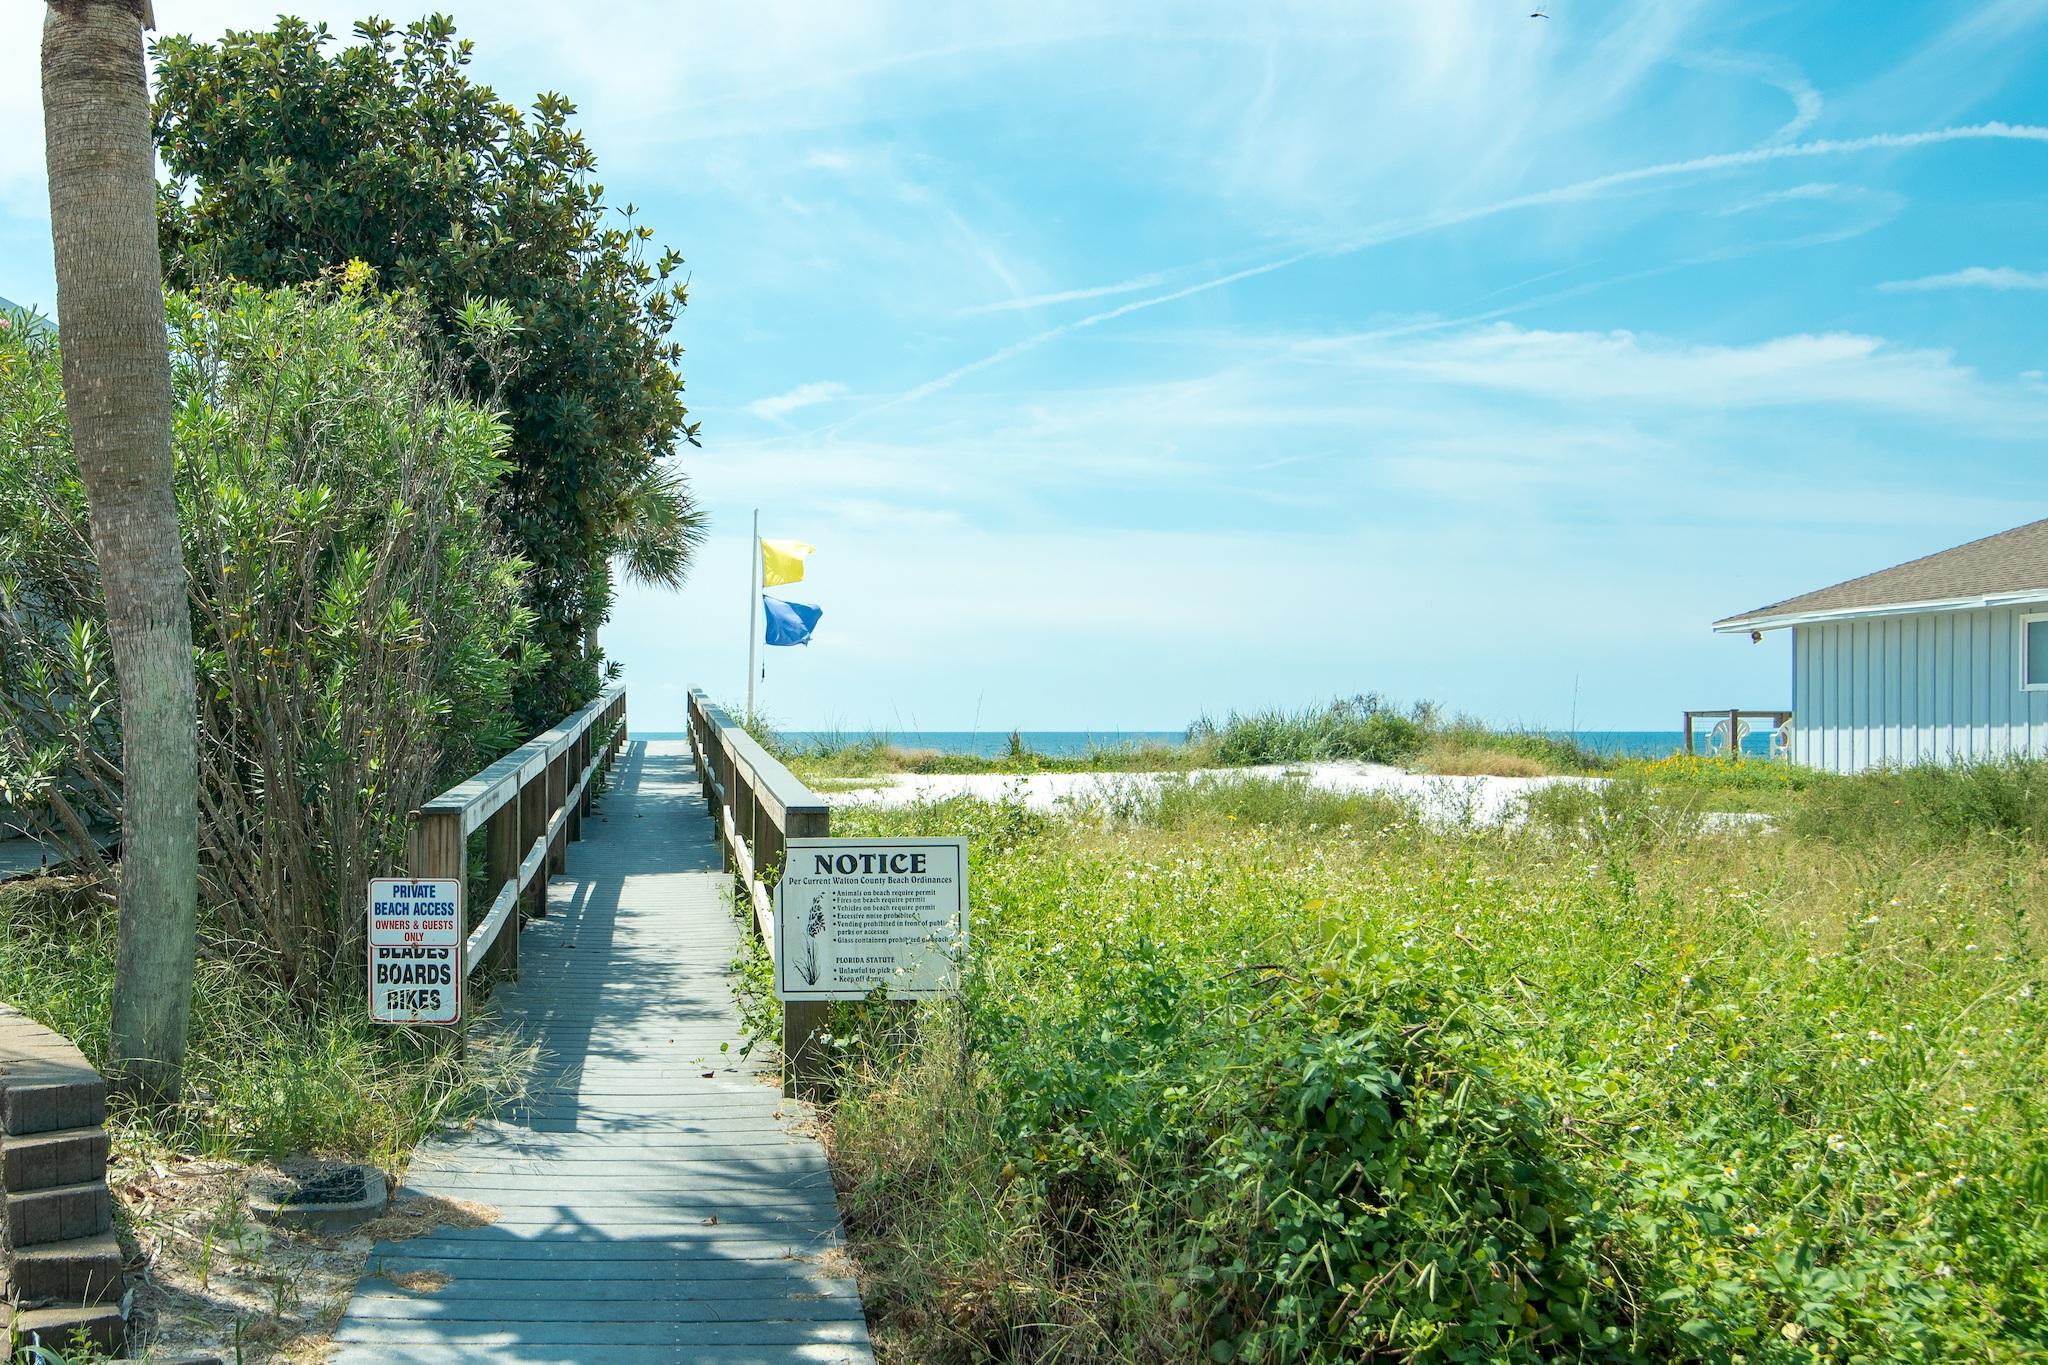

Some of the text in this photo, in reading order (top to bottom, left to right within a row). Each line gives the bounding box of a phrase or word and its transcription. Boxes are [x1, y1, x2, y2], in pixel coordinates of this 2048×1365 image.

[814, 853, 926, 875] NOTICE
[788, 875, 952, 885] Per Current Walton County Beach Ordinances
[393, 885, 436, 898] PRIVATE
[892, 889, 914, 897] require
[915, 889, 936, 897] permit
[374, 902, 454, 916] BEACH ACCESS
[915, 903, 936, 911] permit
[375, 920, 453, 930] OWNERS & GUESTS
[864, 920, 895, 928] prohibited
[404, 932, 424, 942] ONLY
[377, 963, 451, 985] BOARDS
[387, 989, 441, 1011] BIKES
